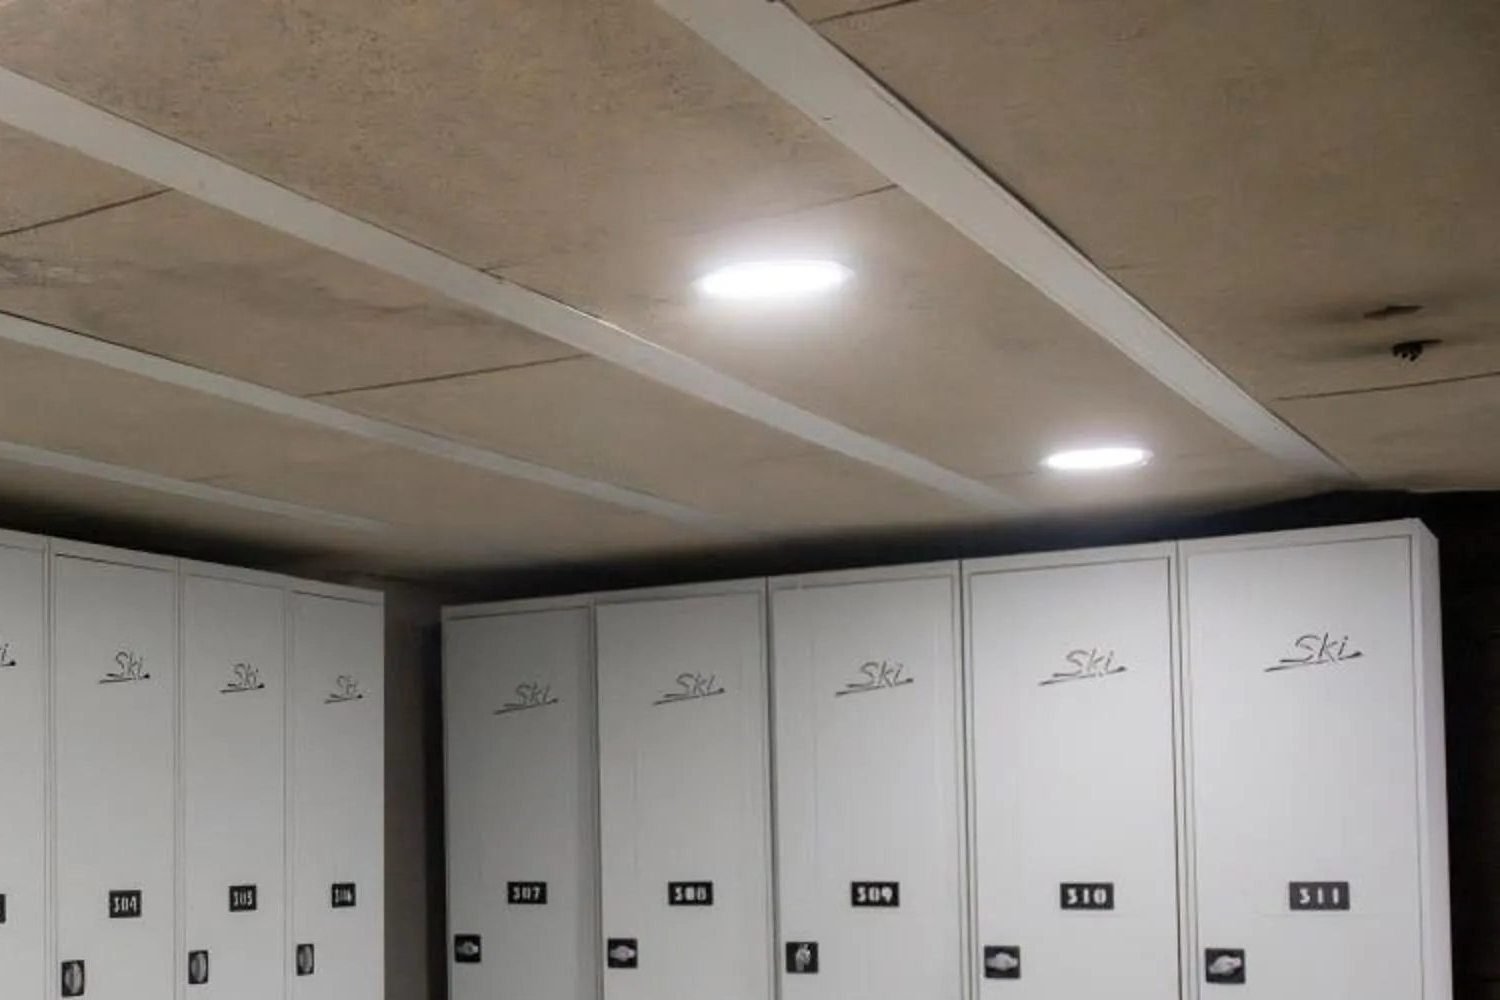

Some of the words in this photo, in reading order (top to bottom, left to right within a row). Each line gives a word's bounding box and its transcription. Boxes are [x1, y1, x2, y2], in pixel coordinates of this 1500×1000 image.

[1280, 632, 1349, 664] Ski
[107, 651, 144, 680] Ski
[846, 661, 904, 688] Ski
[1053, 648, 1114, 677] Ski
[227, 663, 260, 688] Ski
[662, 673, 716, 699] Ski
[503, 682, 551, 707] Ski
[114, 896, 137, 912] 304
[513, 886, 540, 900] 307
[857, 886, 893, 902] 309
[1067, 888, 1107, 905] 310
[1299, 887, 1340, 904] 311
